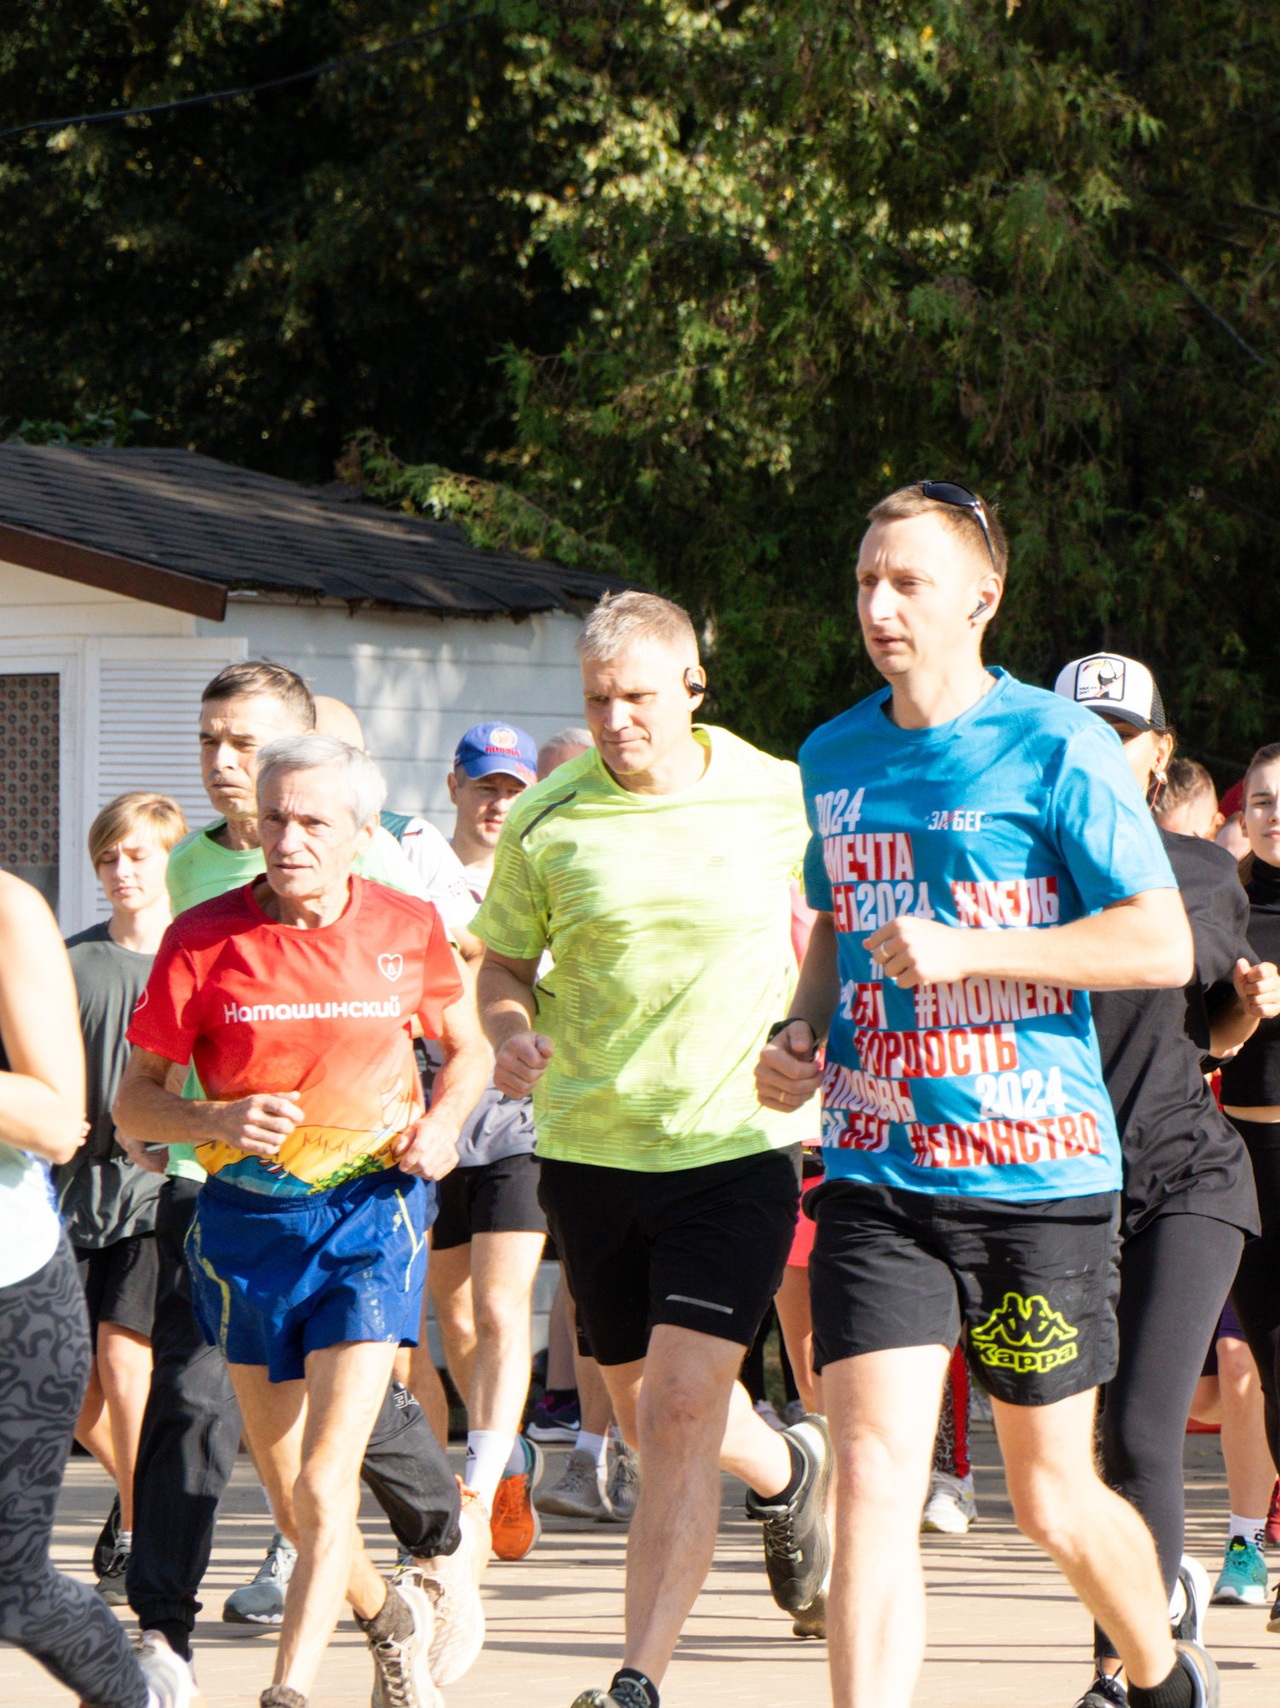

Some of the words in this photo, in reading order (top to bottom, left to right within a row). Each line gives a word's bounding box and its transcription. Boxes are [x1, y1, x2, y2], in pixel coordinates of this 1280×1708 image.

[224, 995, 401, 1023] Наташинский
[976, 1067, 1068, 1120] 2024
[905, 1110, 1102, 1167] #ЕДИНСТВО
[973, 1342, 1078, 1373] Kappa
